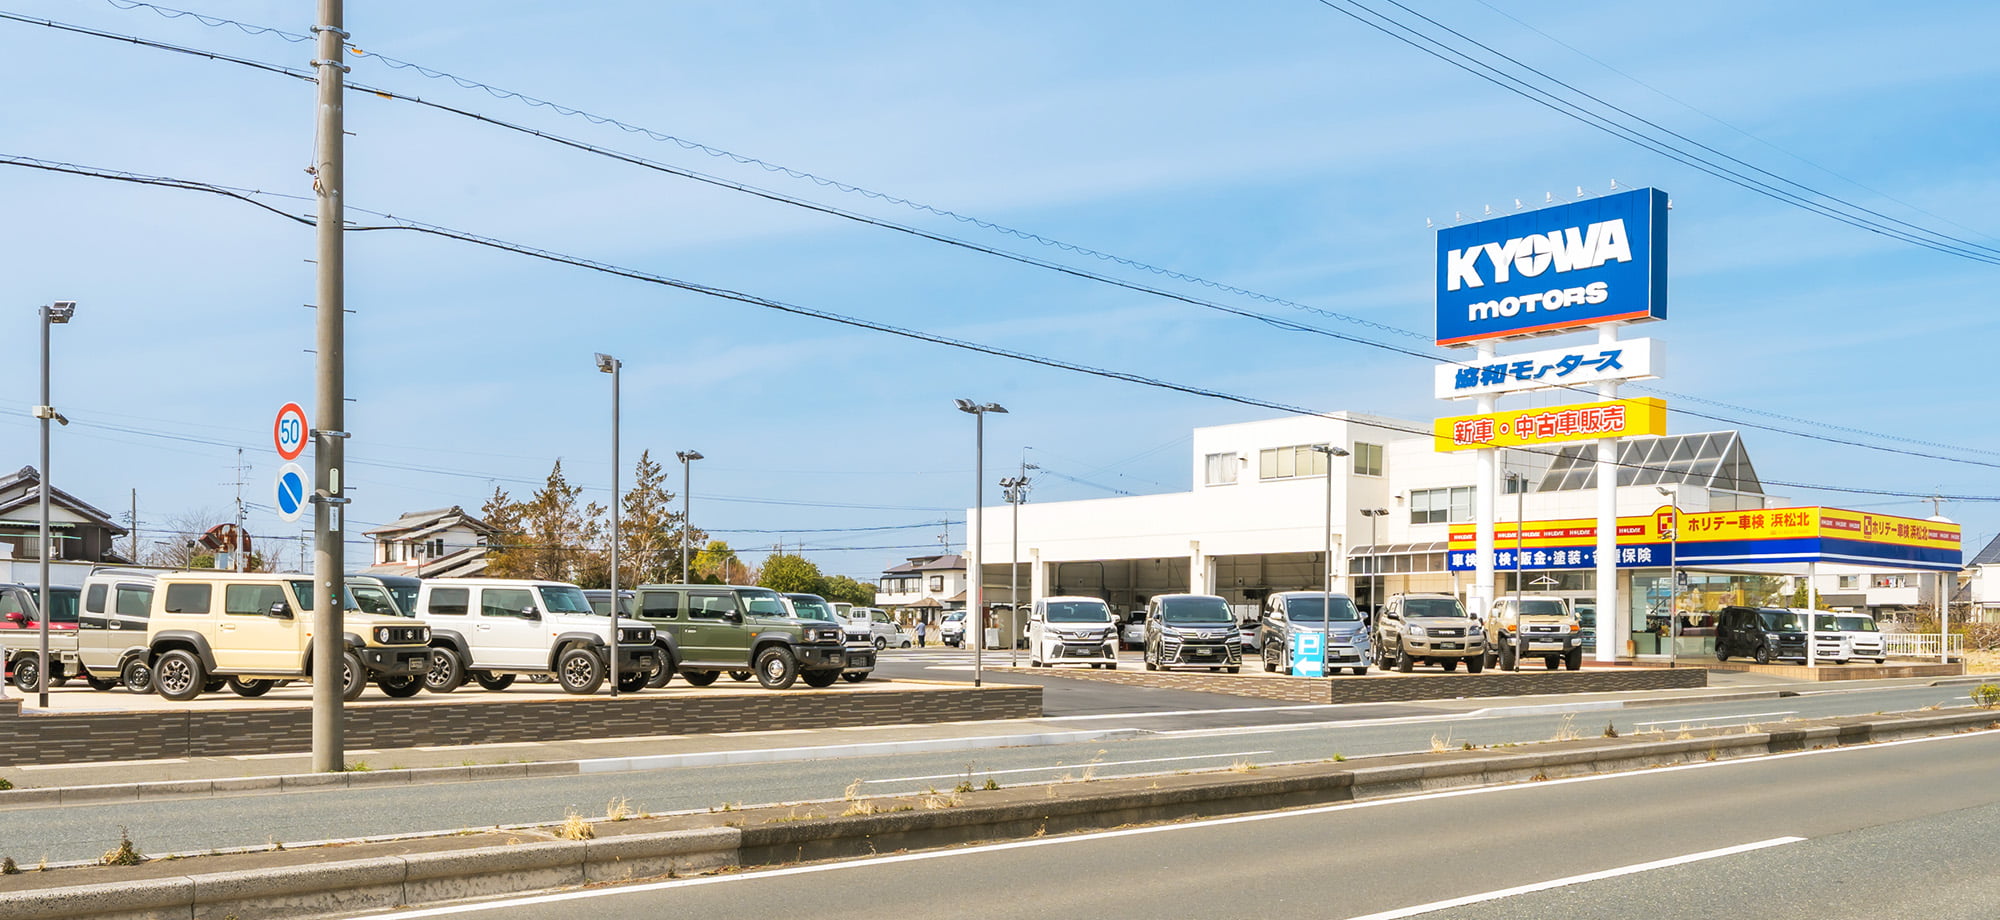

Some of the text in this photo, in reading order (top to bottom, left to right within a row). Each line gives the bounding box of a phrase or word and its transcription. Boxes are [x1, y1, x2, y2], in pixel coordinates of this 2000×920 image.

[1447, 218, 1632, 291] KYOWA
[1454, 349, 1623, 389] 協和モータース
[281, 419, 299, 443] 50
[1454, 404, 1626, 445] 新車・中古車販売
[1688, 514, 1765, 531] ホリデー車検
[1771, 512, 1810, 527] 浜松北
[1299, 635, 1318, 654] P
